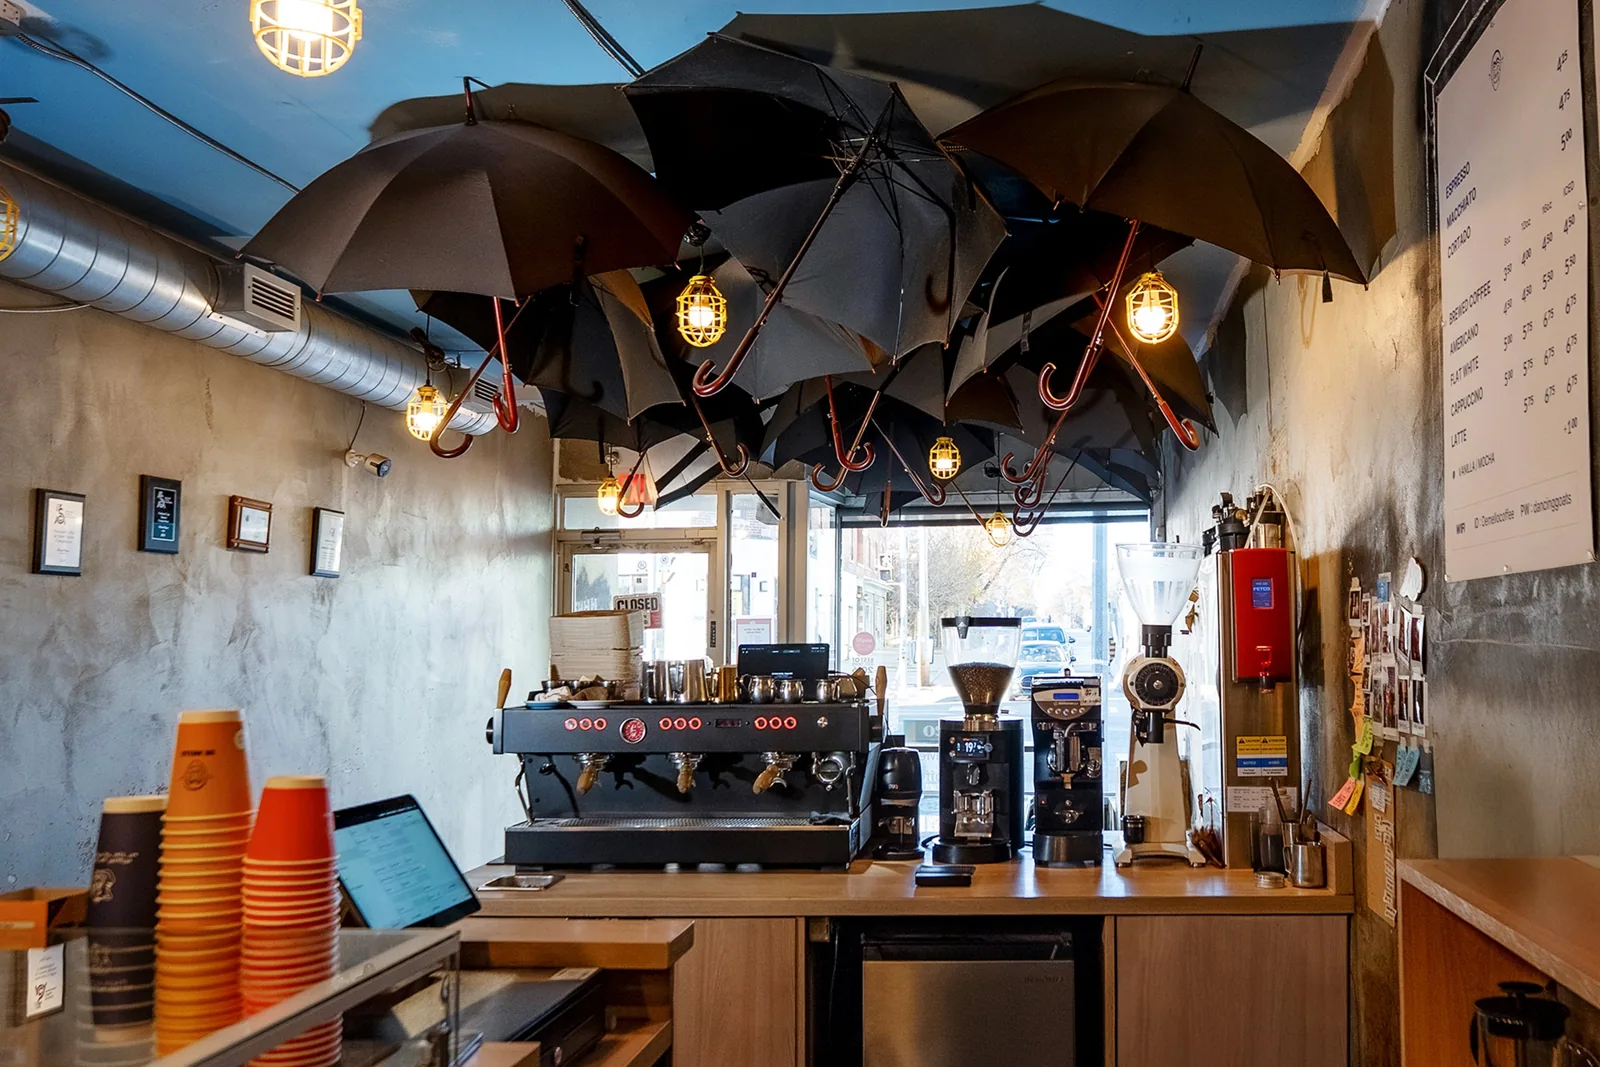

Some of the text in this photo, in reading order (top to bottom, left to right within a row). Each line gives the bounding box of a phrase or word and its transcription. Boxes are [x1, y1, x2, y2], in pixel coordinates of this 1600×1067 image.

[1446, 161, 1471, 200] ESPRESSO
[1563, 180, 1575, 196] ICED
[1446, 186, 1477, 230] MACCHIATO
[1448, 225, 1472, 259] CORTADO
[1449, 298, 1468, 326] BREWED
[1468, 280, 1491, 308] COFFEE
[1450, 323, 1479, 356] AMERICANO
[1450, 367, 1462, 386] FLAT
[1462, 355, 1479, 378] WHITE
[1450, 386, 1484, 416] CAPPUCCINO
[1450, 428, 1466, 448] LATTE
[1458, 460, 1476, 476] VANILLA
[1478, 452, 1496, 468] MOCHA
[616, 597, 658, 610] CLOSED
